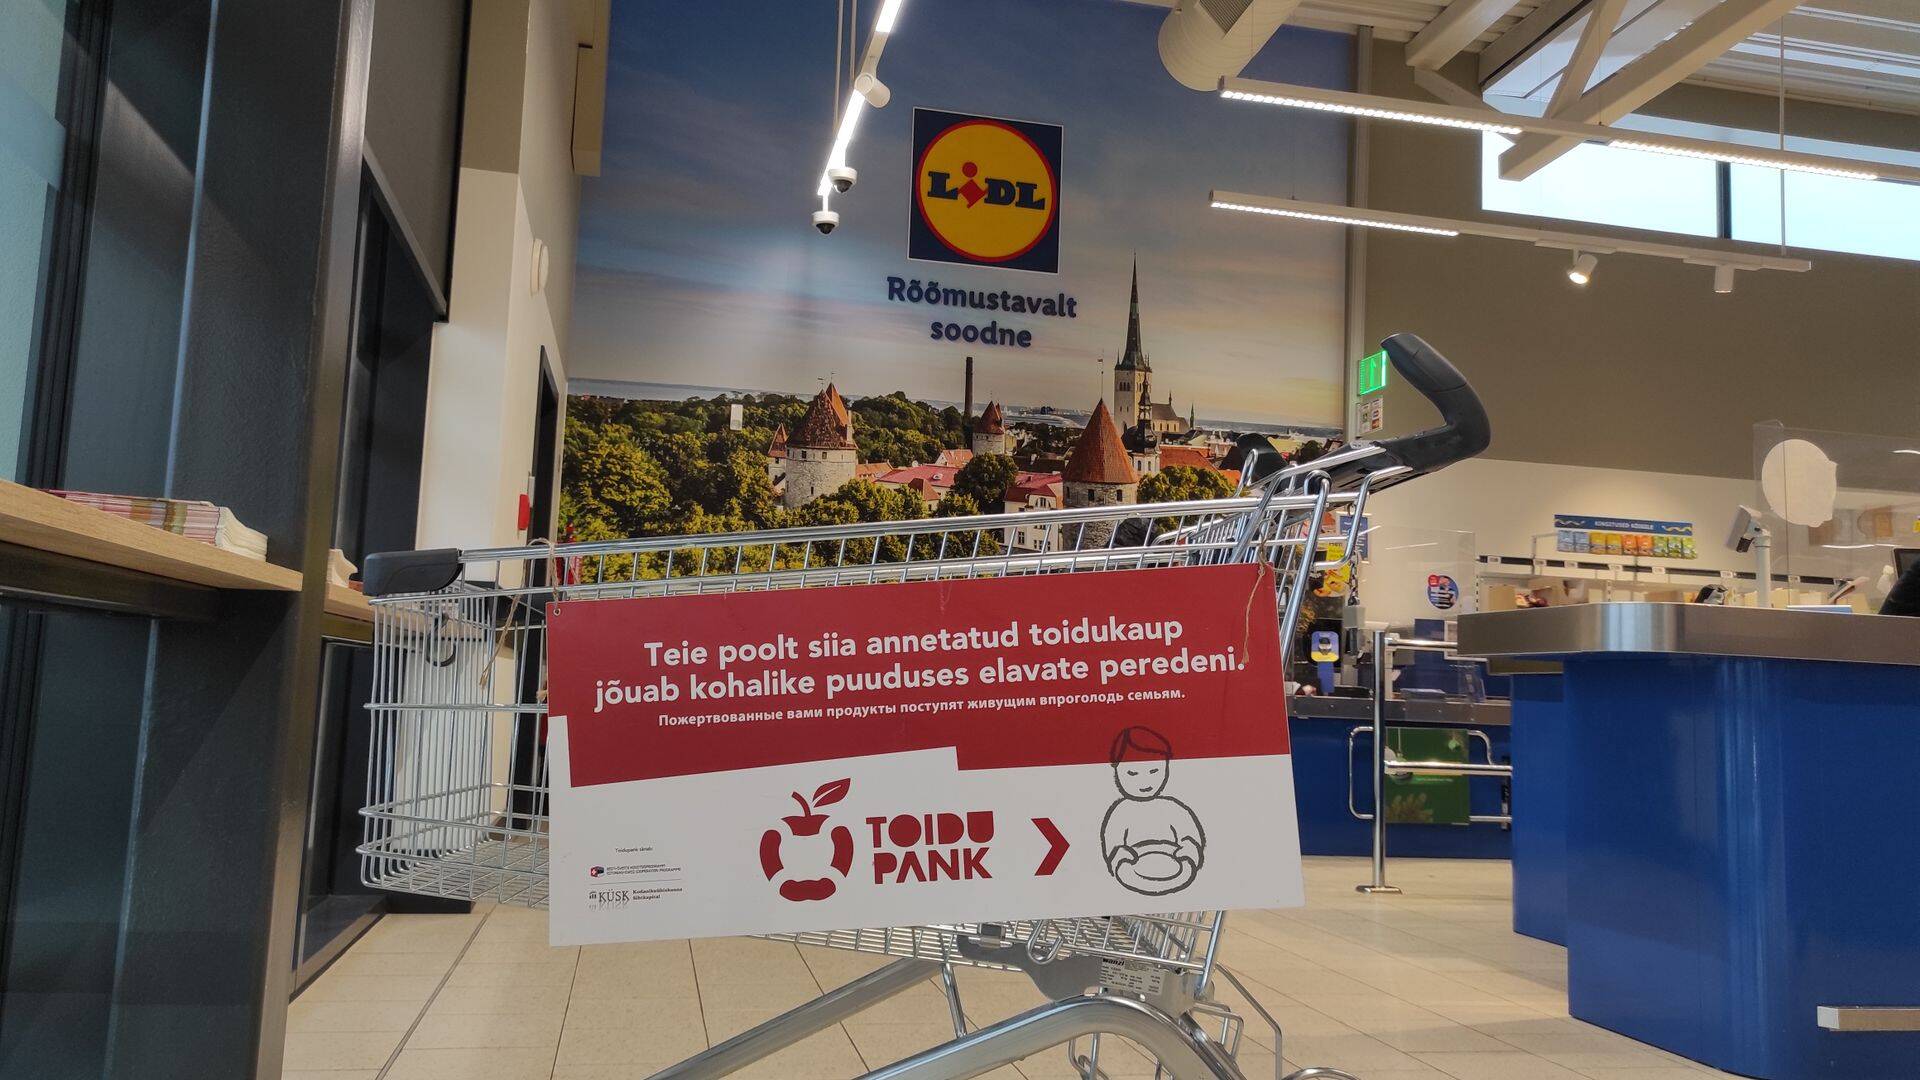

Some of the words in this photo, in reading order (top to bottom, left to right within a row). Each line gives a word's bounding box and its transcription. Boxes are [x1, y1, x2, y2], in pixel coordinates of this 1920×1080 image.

[887, 276, 1077, 318] Rõõmustavalt
[930, 321, 1032, 348] soodne
[644, 640, 708, 667] Teie
[719, 633, 799, 670] poolt
[808, 632, 857, 658] siia
[866, 621, 1019, 655] annetatud
[1029, 616, 1183, 646] toidukaup
[594, 675, 680, 713] jõuab
[690, 669, 815, 700] kohalike
[827, 663, 969, 699] puuduses
[979, 657, 1089, 684] elavate
[1100, 646, 1245, 684] peredeni.
[658, 710, 783, 727] Пожертвованные
[787, 707, 823, 720] вами
[827, 703, 897, 718] продукты
[900, 700, 964, 713] поступят
[967, 696, 1036, 710] живущим
[1040, 691, 1124, 707] впроголодь
[1128, 688, 1186, 701] семьям.
[866, 811, 994, 848] TOIDU
[873, 847, 993, 885] PANK
[599, 889, 630, 902] KÜSK
